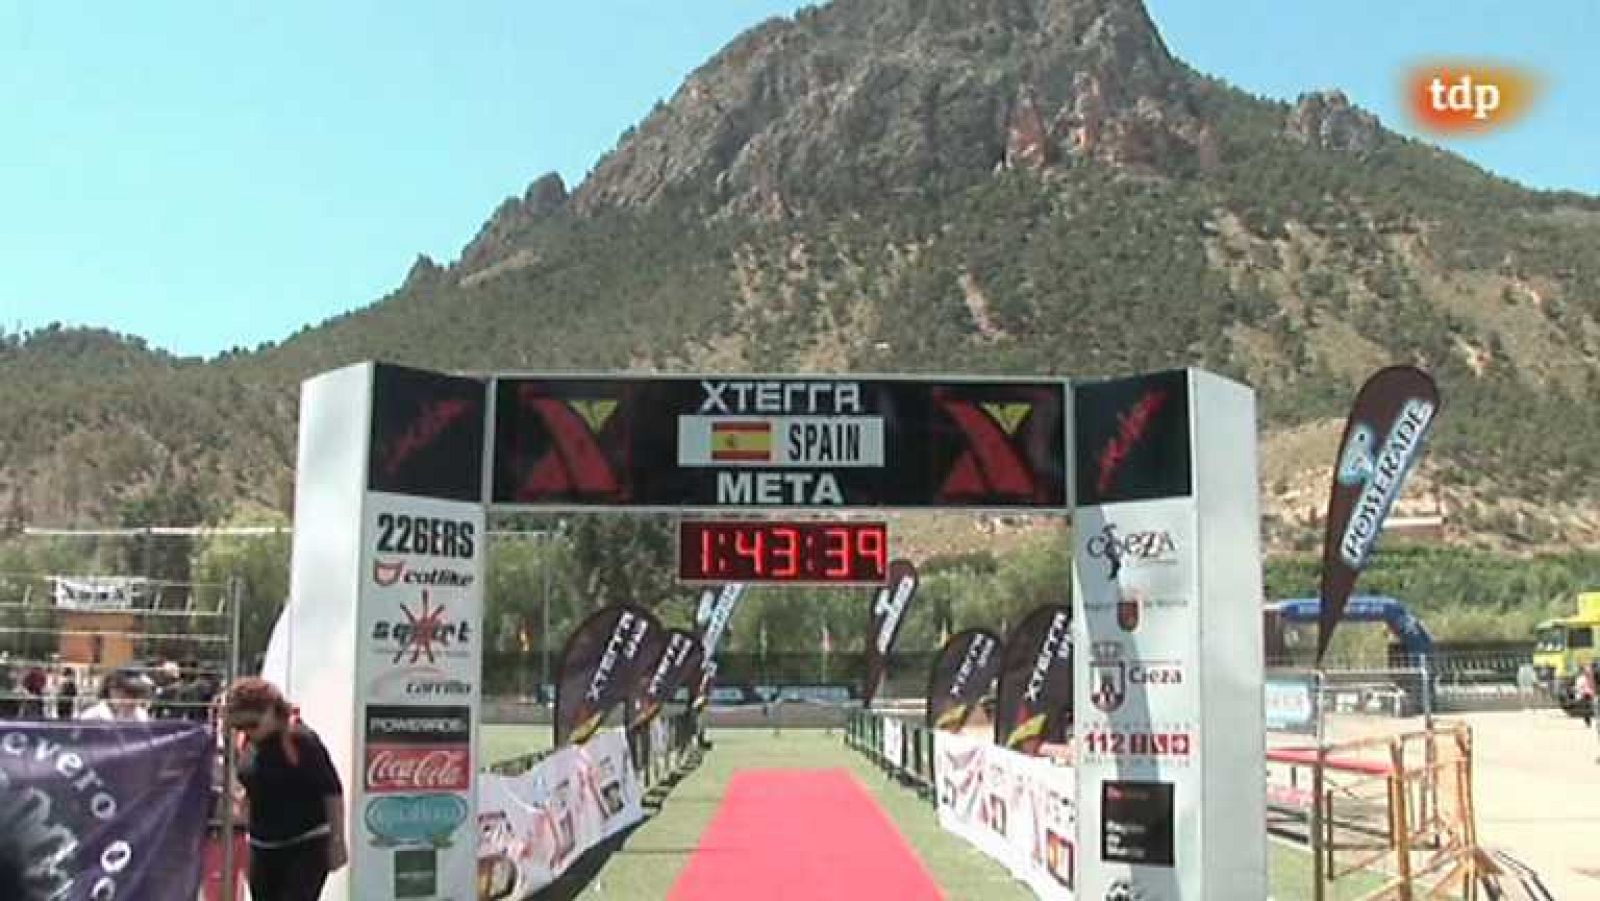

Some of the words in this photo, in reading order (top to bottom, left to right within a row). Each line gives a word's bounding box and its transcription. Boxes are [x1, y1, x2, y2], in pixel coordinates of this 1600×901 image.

[702, 382, 861, 413] XTERRA
[787, 421, 861, 462] SPAIN
[717, 473, 843, 504] META
[1344, 400, 1435, 562] POWERADE
[376, 513, 475, 559] 226ERS
[700, 526, 886, 577] 1:43:39
[1084, 732, 1125, 753] 112
